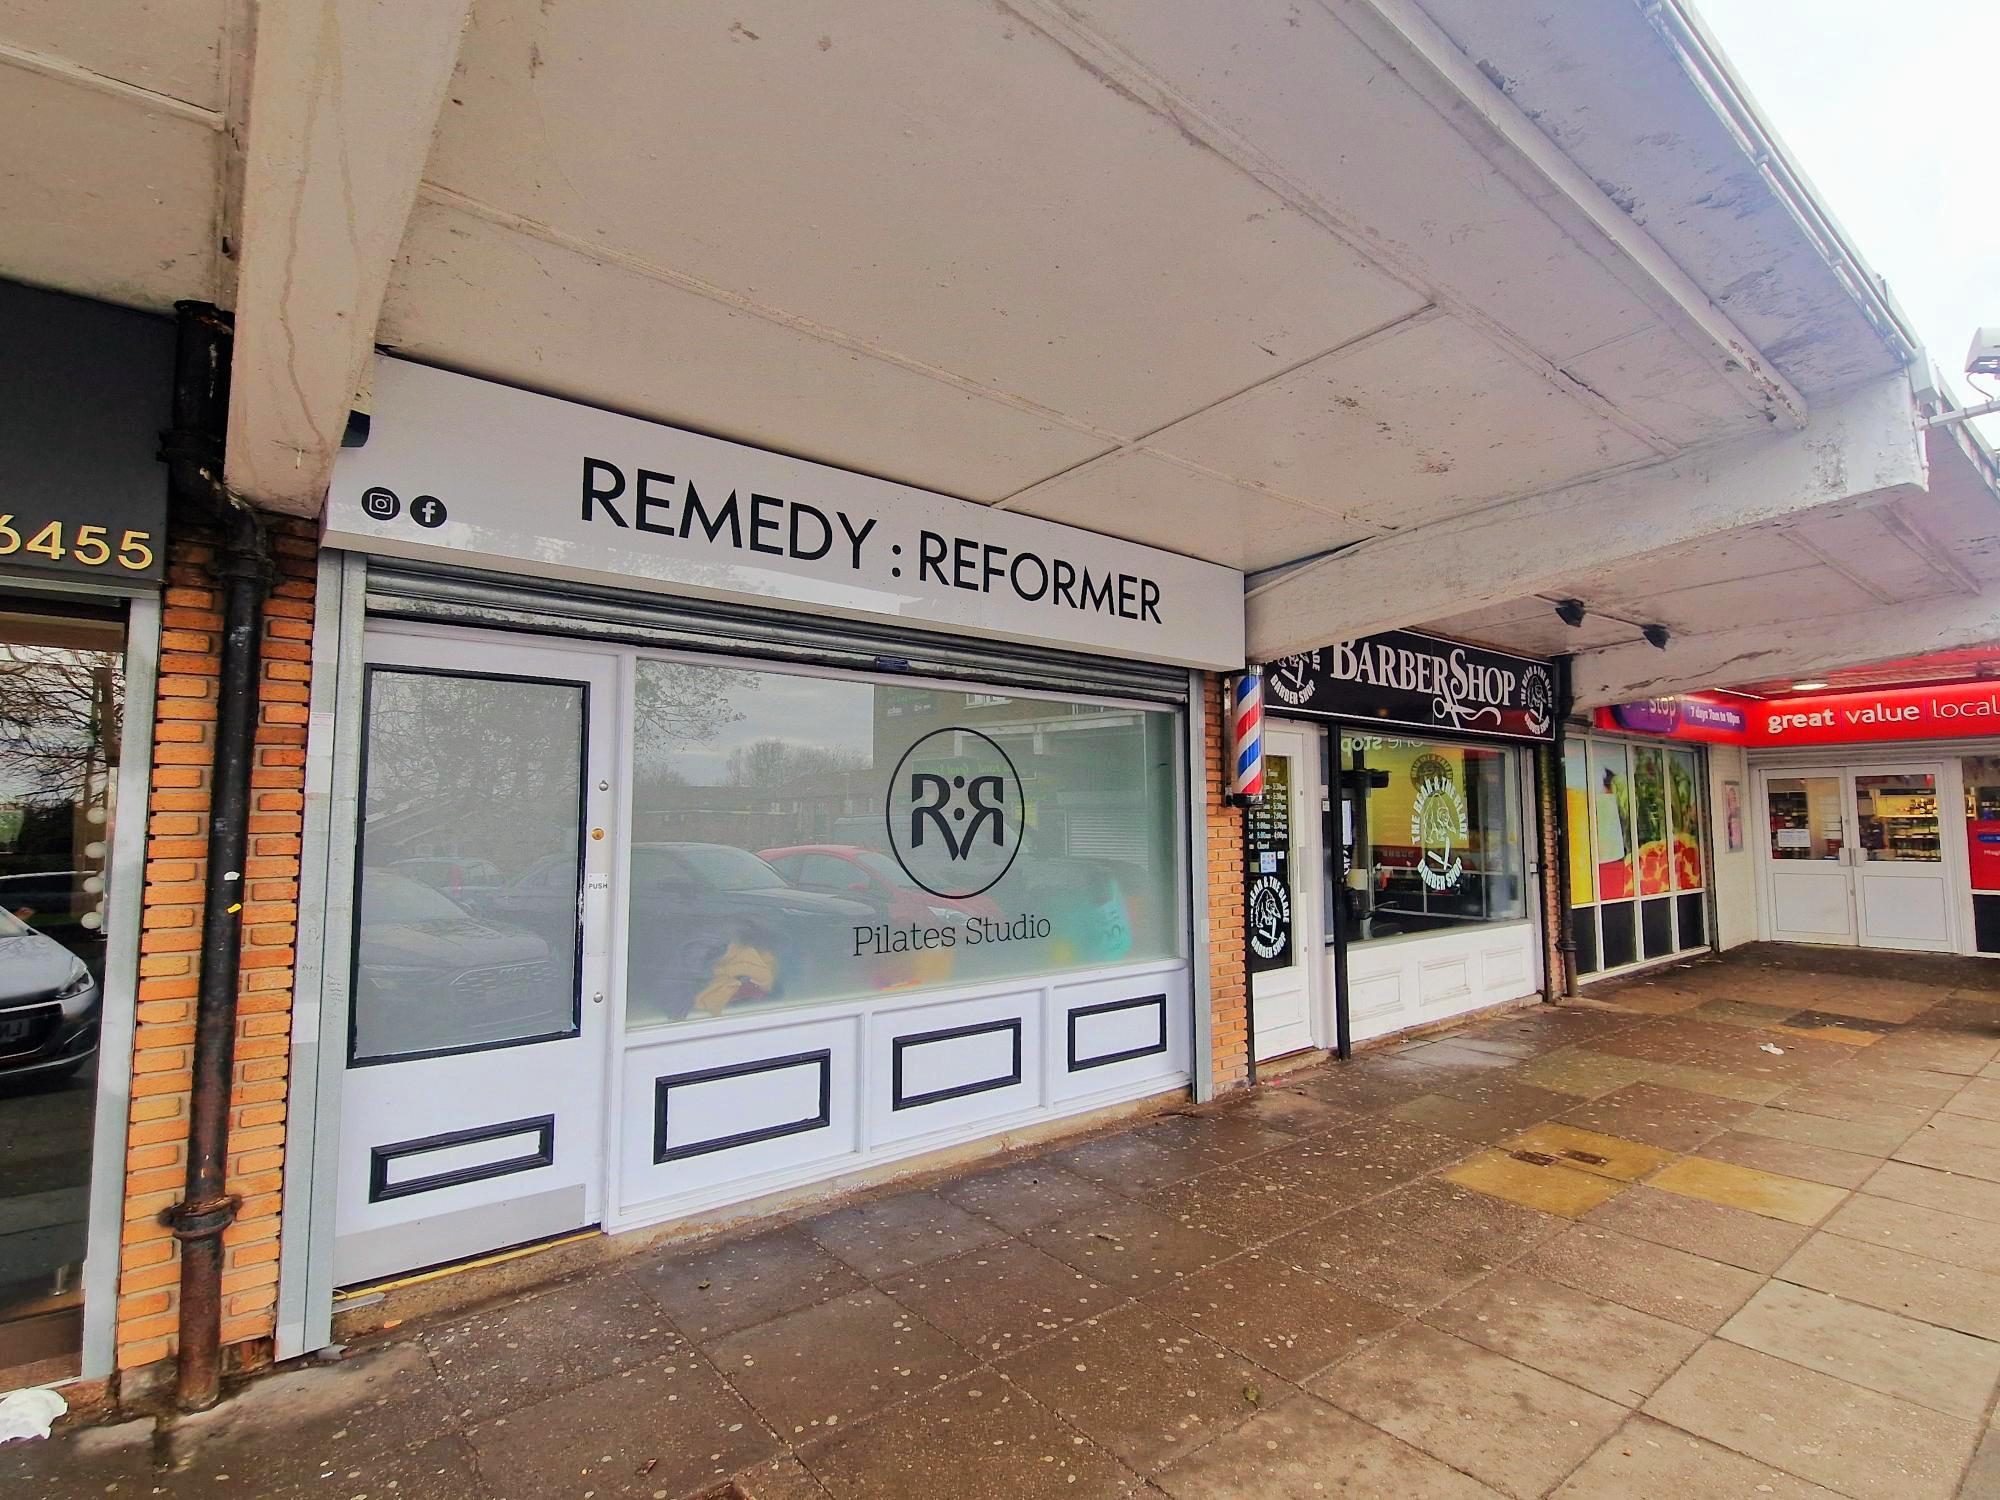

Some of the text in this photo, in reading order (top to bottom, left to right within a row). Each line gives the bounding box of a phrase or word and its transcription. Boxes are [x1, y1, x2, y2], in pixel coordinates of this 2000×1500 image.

[0, 514, 153, 570] 6455
[581, 456, 878, 570] REMEDY
[919, 529, 1163, 625] REFORMER
[1270, 673, 1316, 705] BARBER SHOP
[1767, 694, 2000, 734] great value local
[1411, 775, 1468, 844] THE BEAR & THE BLADE
[1417, 856, 1463, 891] BARBER SHOP
[1269, 875, 1282, 893] THE
[1278, 887, 1290, 923] BLADE
[853, 913, 1052, 957] Pilates Studio
[1250, 931, 1287, 959] BARBER SHOP
